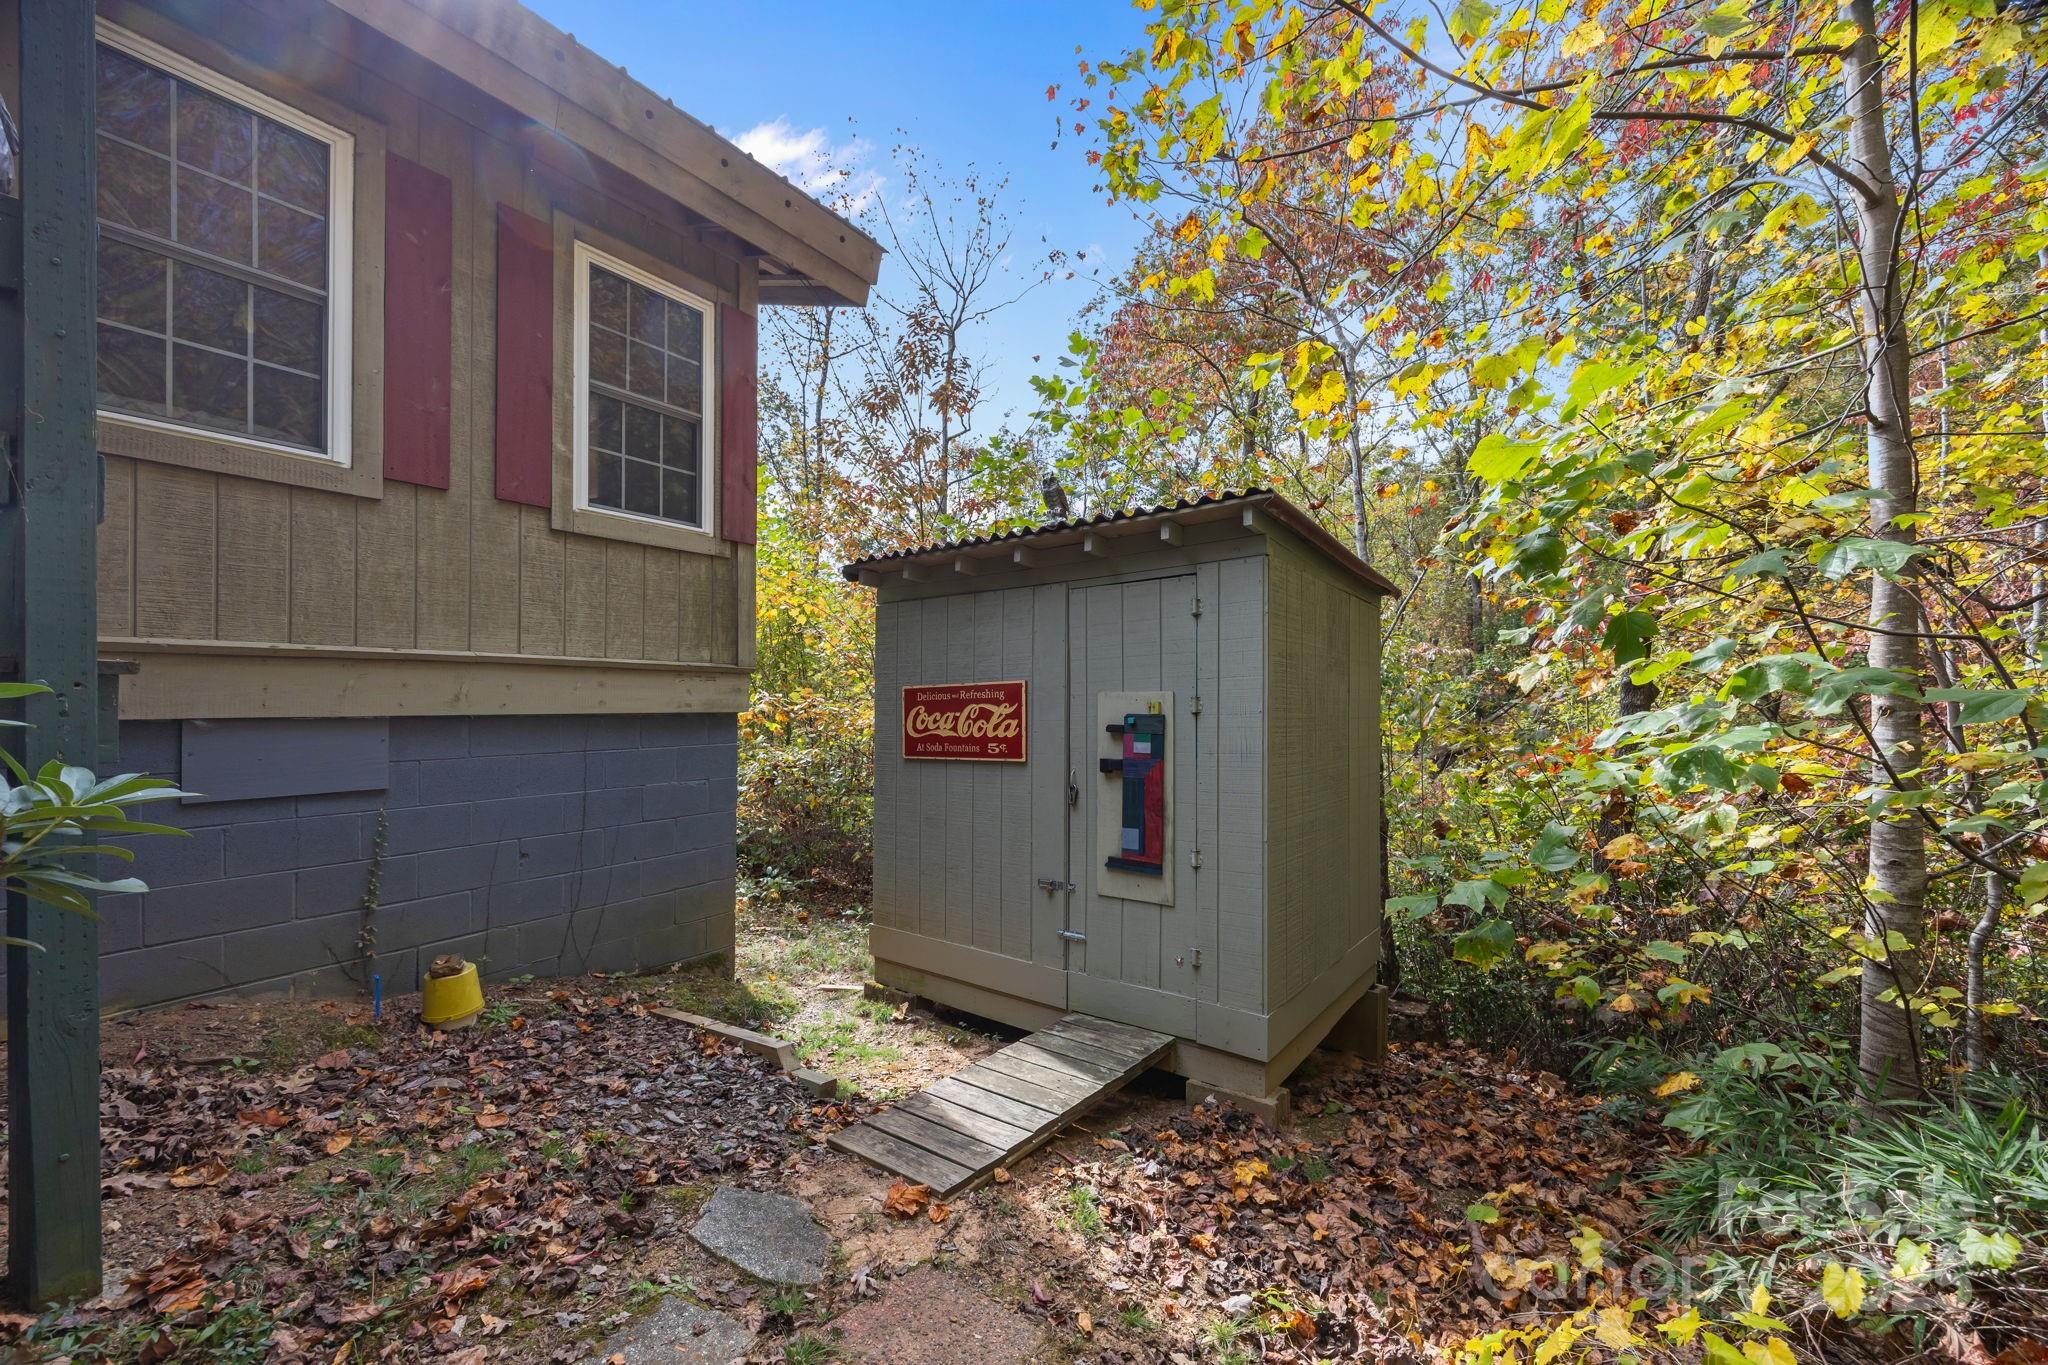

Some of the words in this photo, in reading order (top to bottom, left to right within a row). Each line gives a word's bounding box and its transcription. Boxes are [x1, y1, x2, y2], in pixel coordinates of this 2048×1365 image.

[917, 691, 951, 701] Delicious
[960, 689, 1005, 700] Refreshing
[906, 703, 1020, 738] Coca-Cola
[916, 743, 925, 752] At
[926, 743, 943, 752] Soda
[944, 743, 980, 752] Fountains
